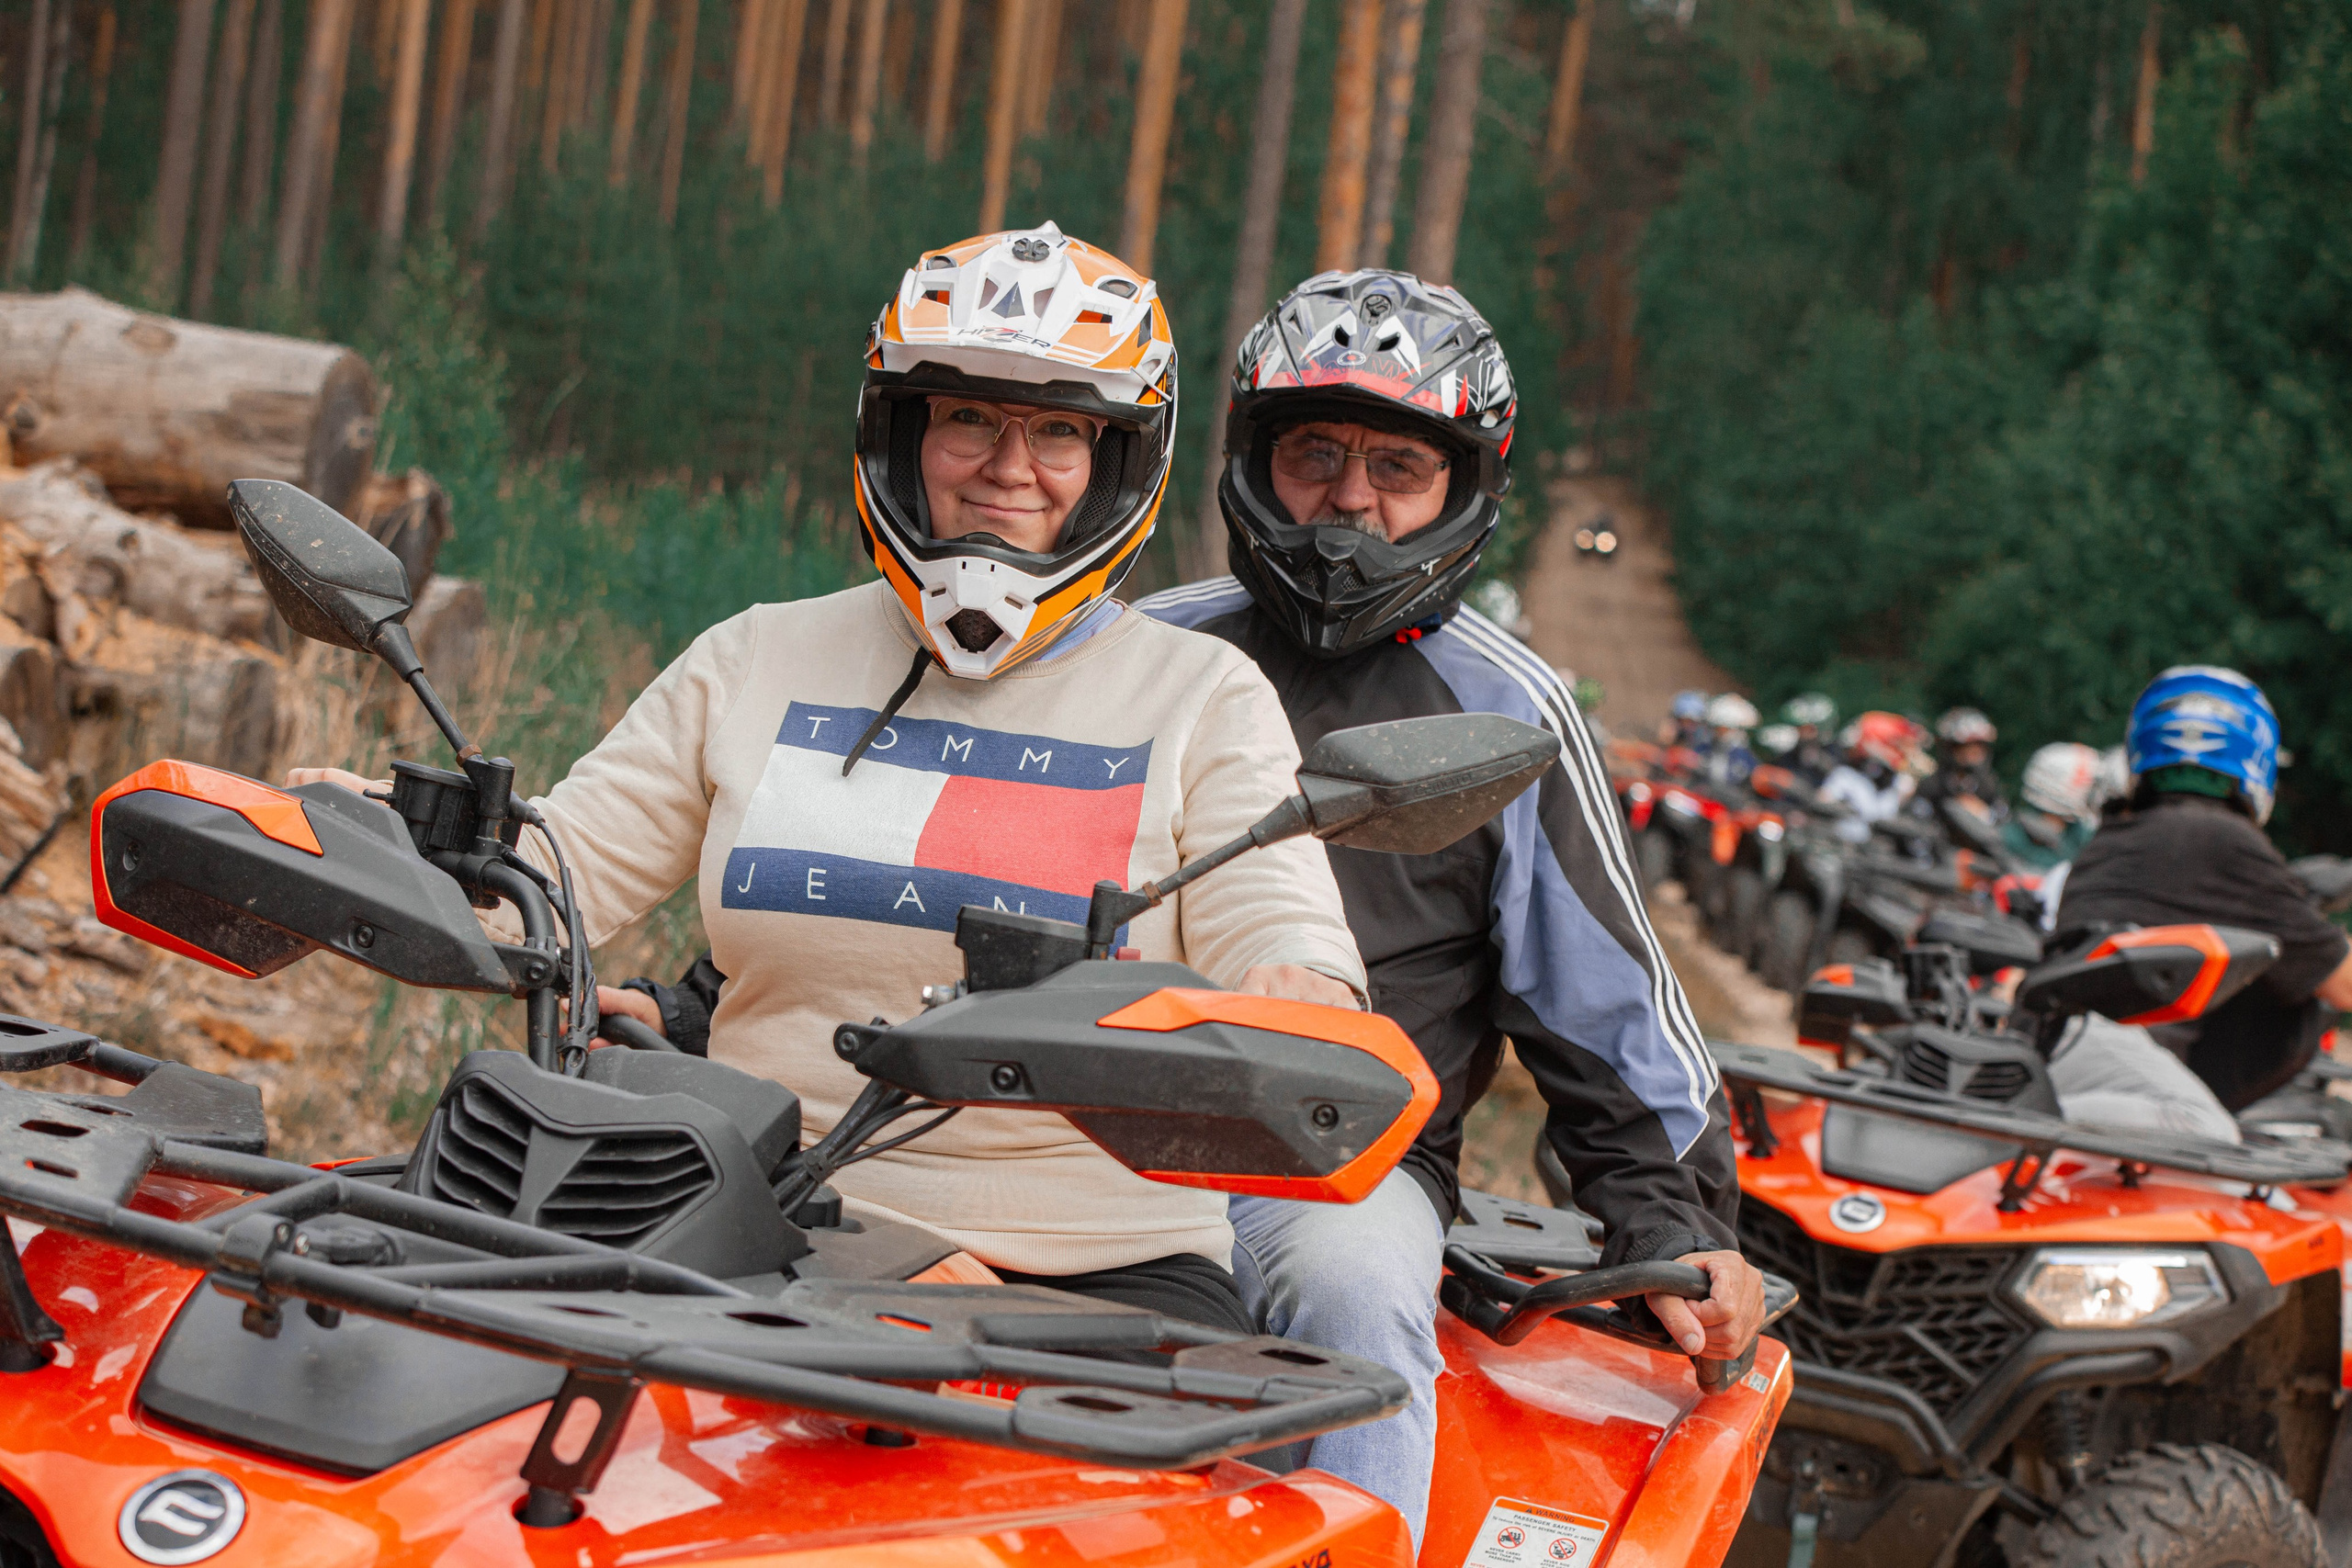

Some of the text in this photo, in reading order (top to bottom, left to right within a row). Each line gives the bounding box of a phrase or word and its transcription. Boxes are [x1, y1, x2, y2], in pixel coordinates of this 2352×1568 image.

[807, 716, 1130, 779] TOMMY
[737, 862, 1025, 916] JEA
[1513, 1515, 1577, 1532] PASSENGER SAFETY
[1536, 1509, 1576, 1523] WARNING
[1488, 1554, 1515, 1563] PASSENGER
